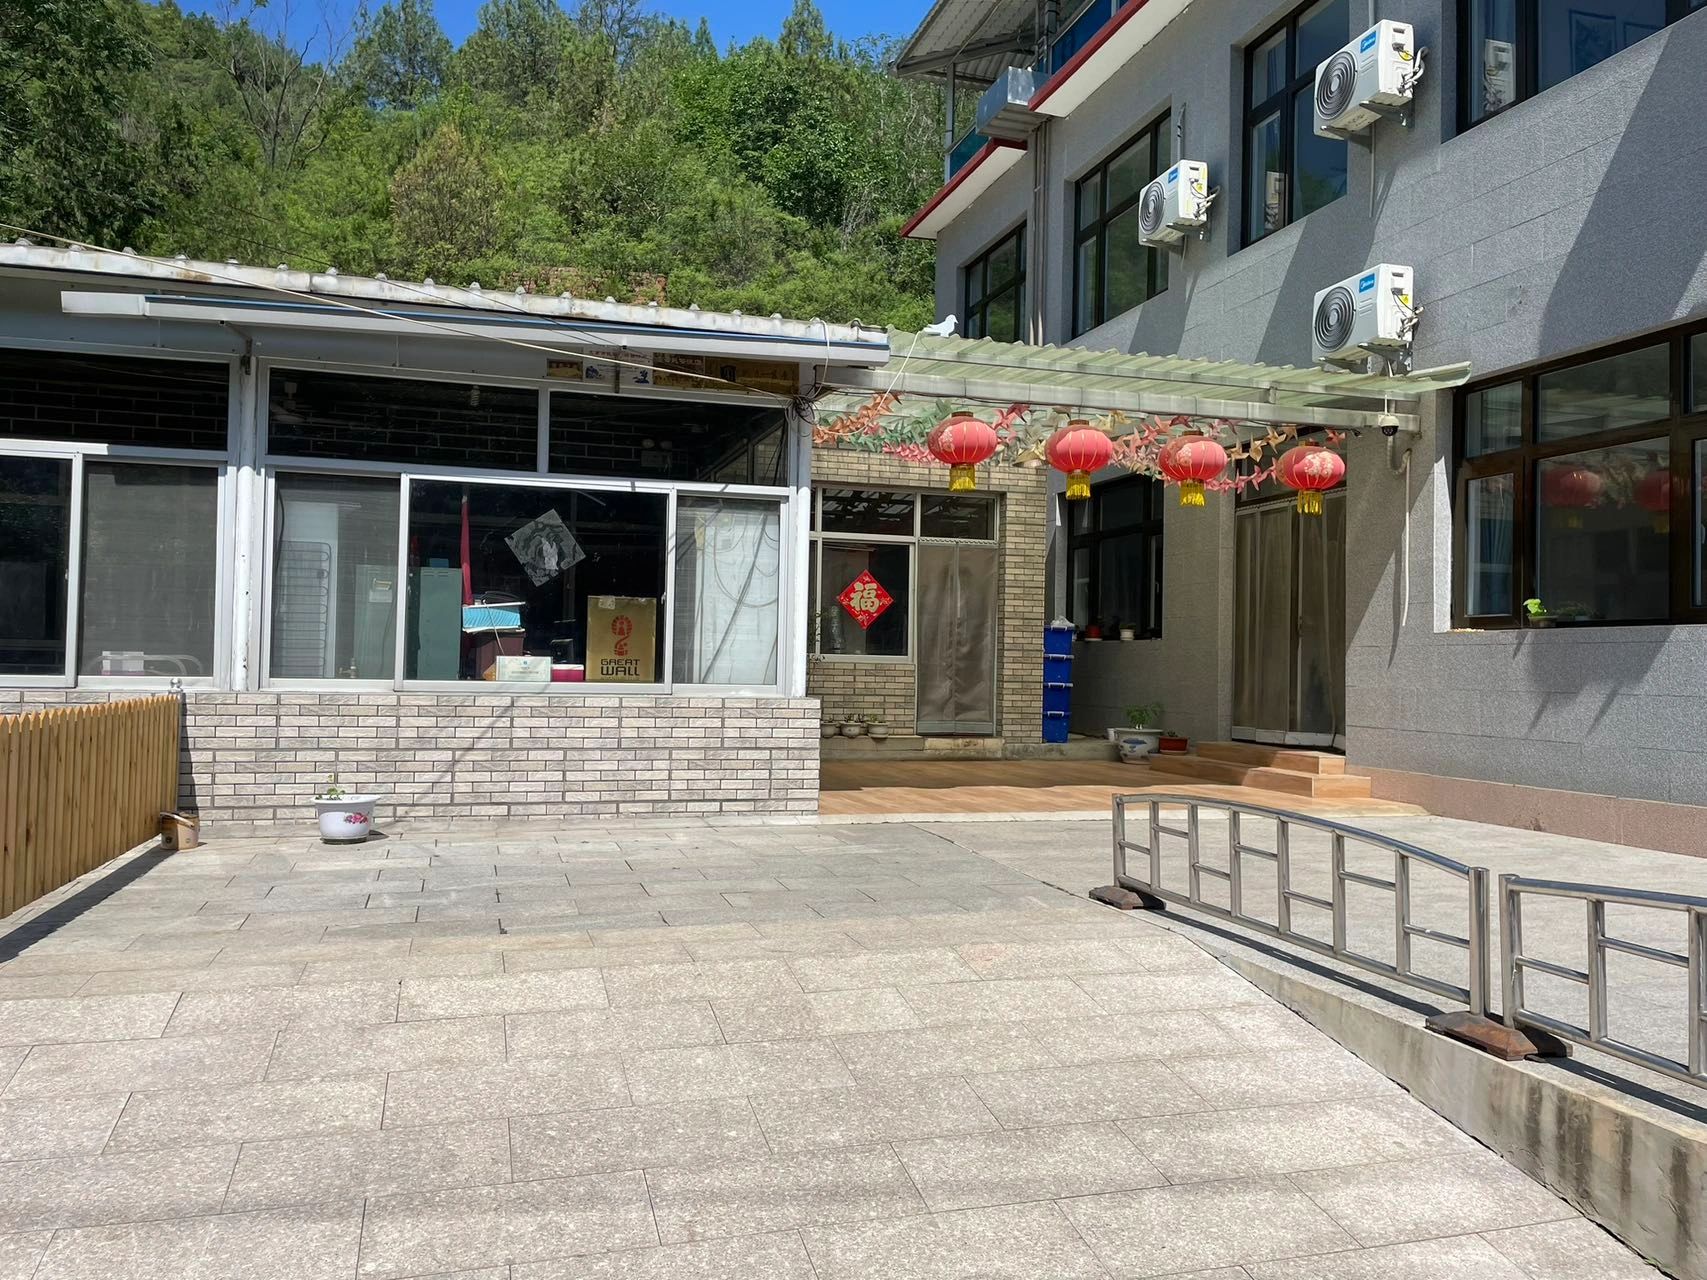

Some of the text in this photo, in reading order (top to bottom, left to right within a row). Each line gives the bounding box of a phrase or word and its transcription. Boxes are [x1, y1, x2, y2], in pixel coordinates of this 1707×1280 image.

[850, 581, 880, 613] 福
[600, 658, 640, 666] GREAT
[600, 666, 640, 676] WALL
